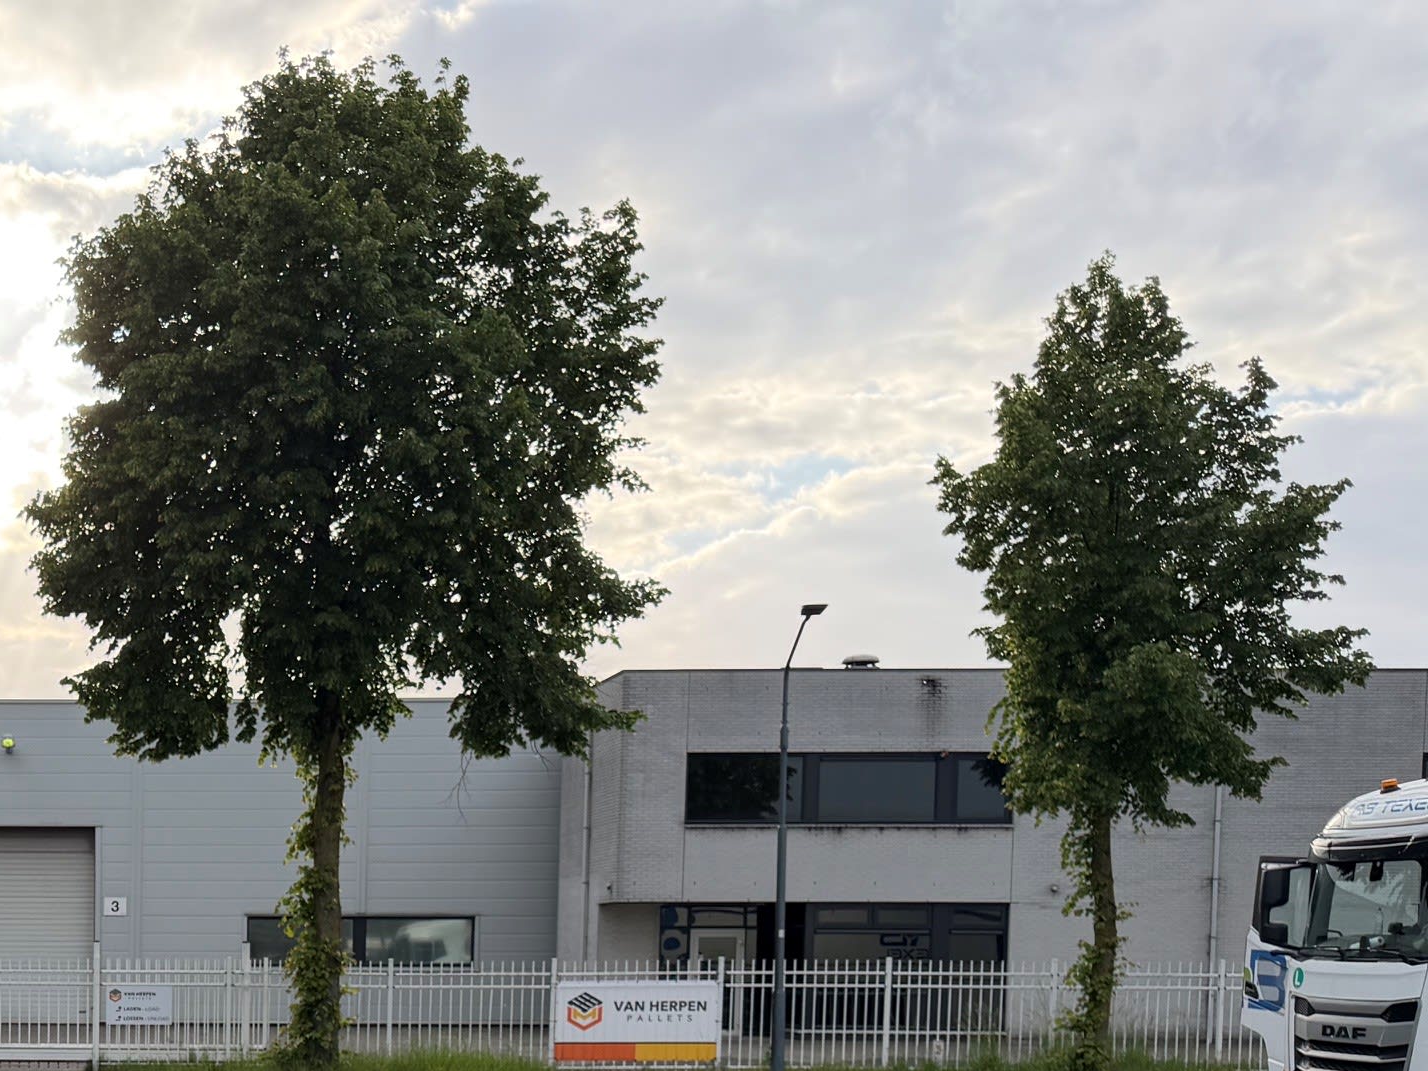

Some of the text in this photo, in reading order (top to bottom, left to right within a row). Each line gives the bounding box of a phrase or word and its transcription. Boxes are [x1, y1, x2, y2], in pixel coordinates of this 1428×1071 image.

[1381, 799, 1428, 813] TEXE
[111, 900, 119, 912] 3
[614, 1001, 707, 1012] VAN HERPEN
[627, 1014, 693, 1022] PALLETS
[1322, 1025, 1366, 1039] DAF
